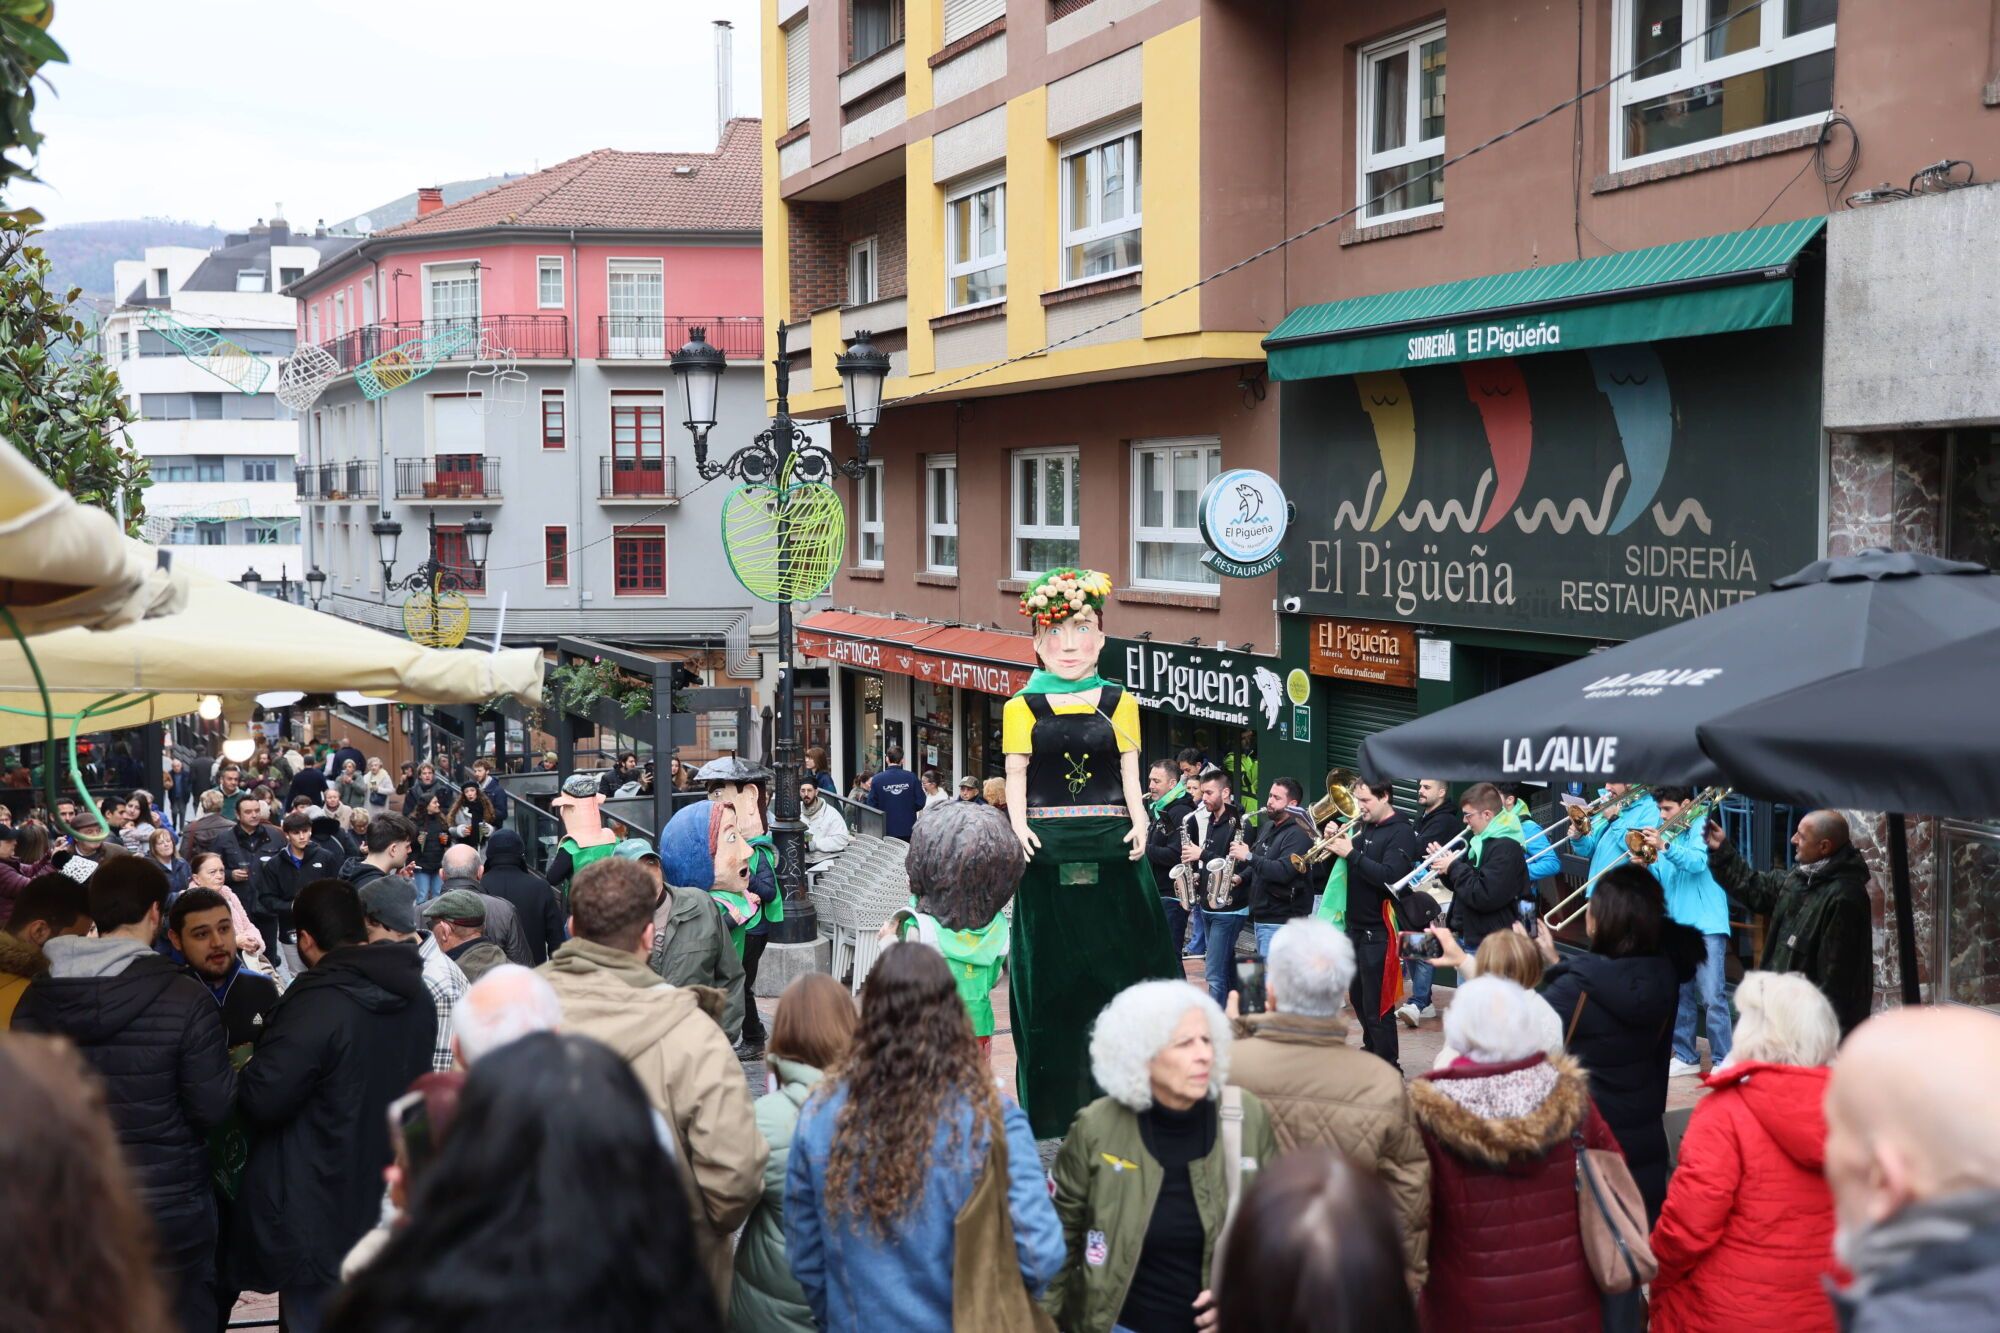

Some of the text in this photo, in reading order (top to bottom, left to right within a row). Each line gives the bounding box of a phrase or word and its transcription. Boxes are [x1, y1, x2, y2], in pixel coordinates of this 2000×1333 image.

[1408, 322, 1560, 361] SIDRERÍA El Pigüeña
[1225, 525, 1273, 539] El Pigüeña
[1215, 553, 1282, 577] RESTAURANTE
[1625, 541, 1758, 582] SIDRERÍA
[1308, 539, 1344, 594] El
[1356, 540, 1517, 616] Pigüeña
[1319, 622, 1400, 659] El Pigüeña
[1334, 664, 1386, 680] Cocina tradicional
[1362, 654, 1400, 665] Restaurante
[1126, 644, 1251, 713] El Pigüeña
[1615, 668, 1723, 687] SALVE
[1189, 703, 1249, 726] Restaurante
[1502, 736, 1619, 773] LA SALVE
